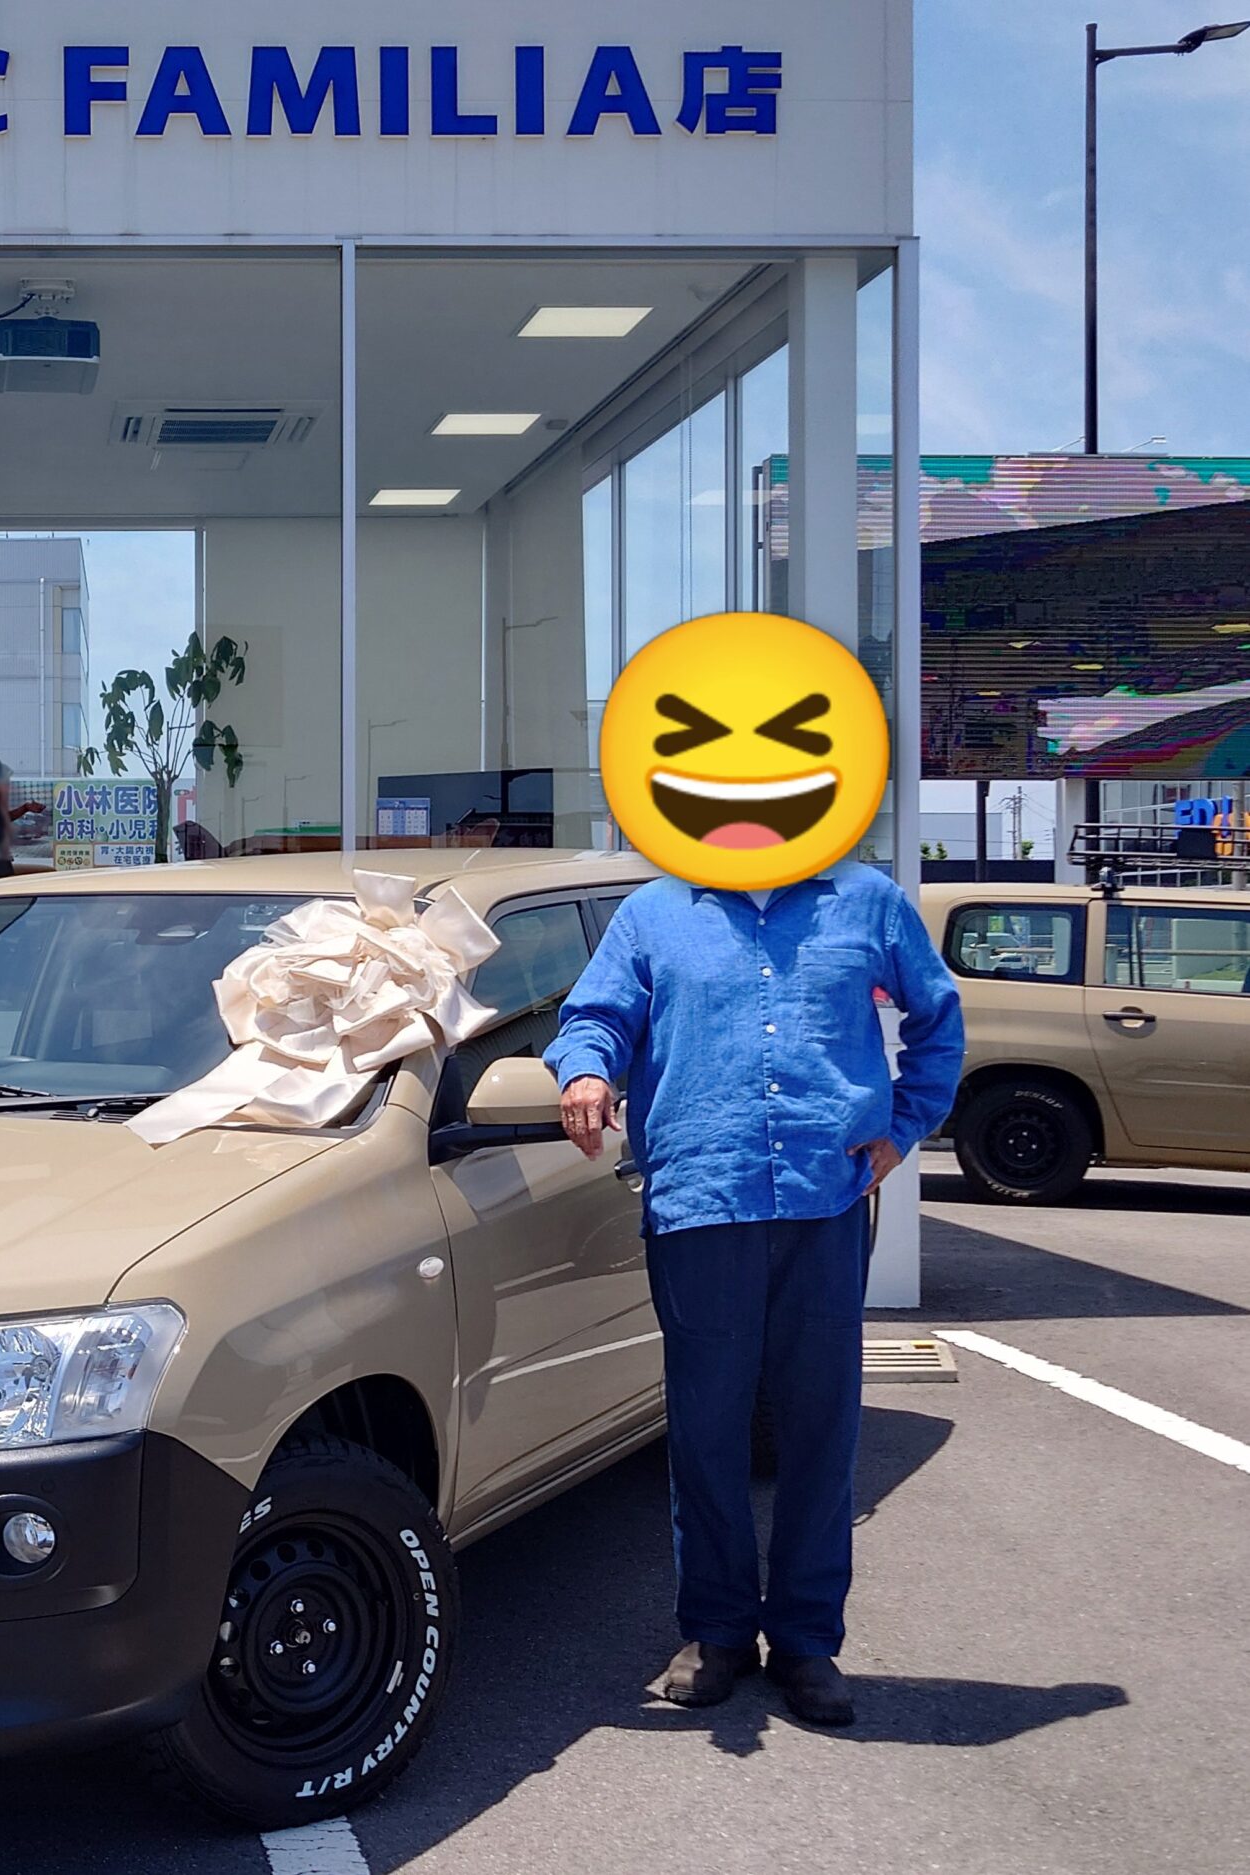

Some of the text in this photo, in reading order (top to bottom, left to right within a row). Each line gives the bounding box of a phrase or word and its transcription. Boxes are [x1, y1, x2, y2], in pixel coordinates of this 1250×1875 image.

[295, 1528, 440, 1798] OPEN COUNTRY R/T
